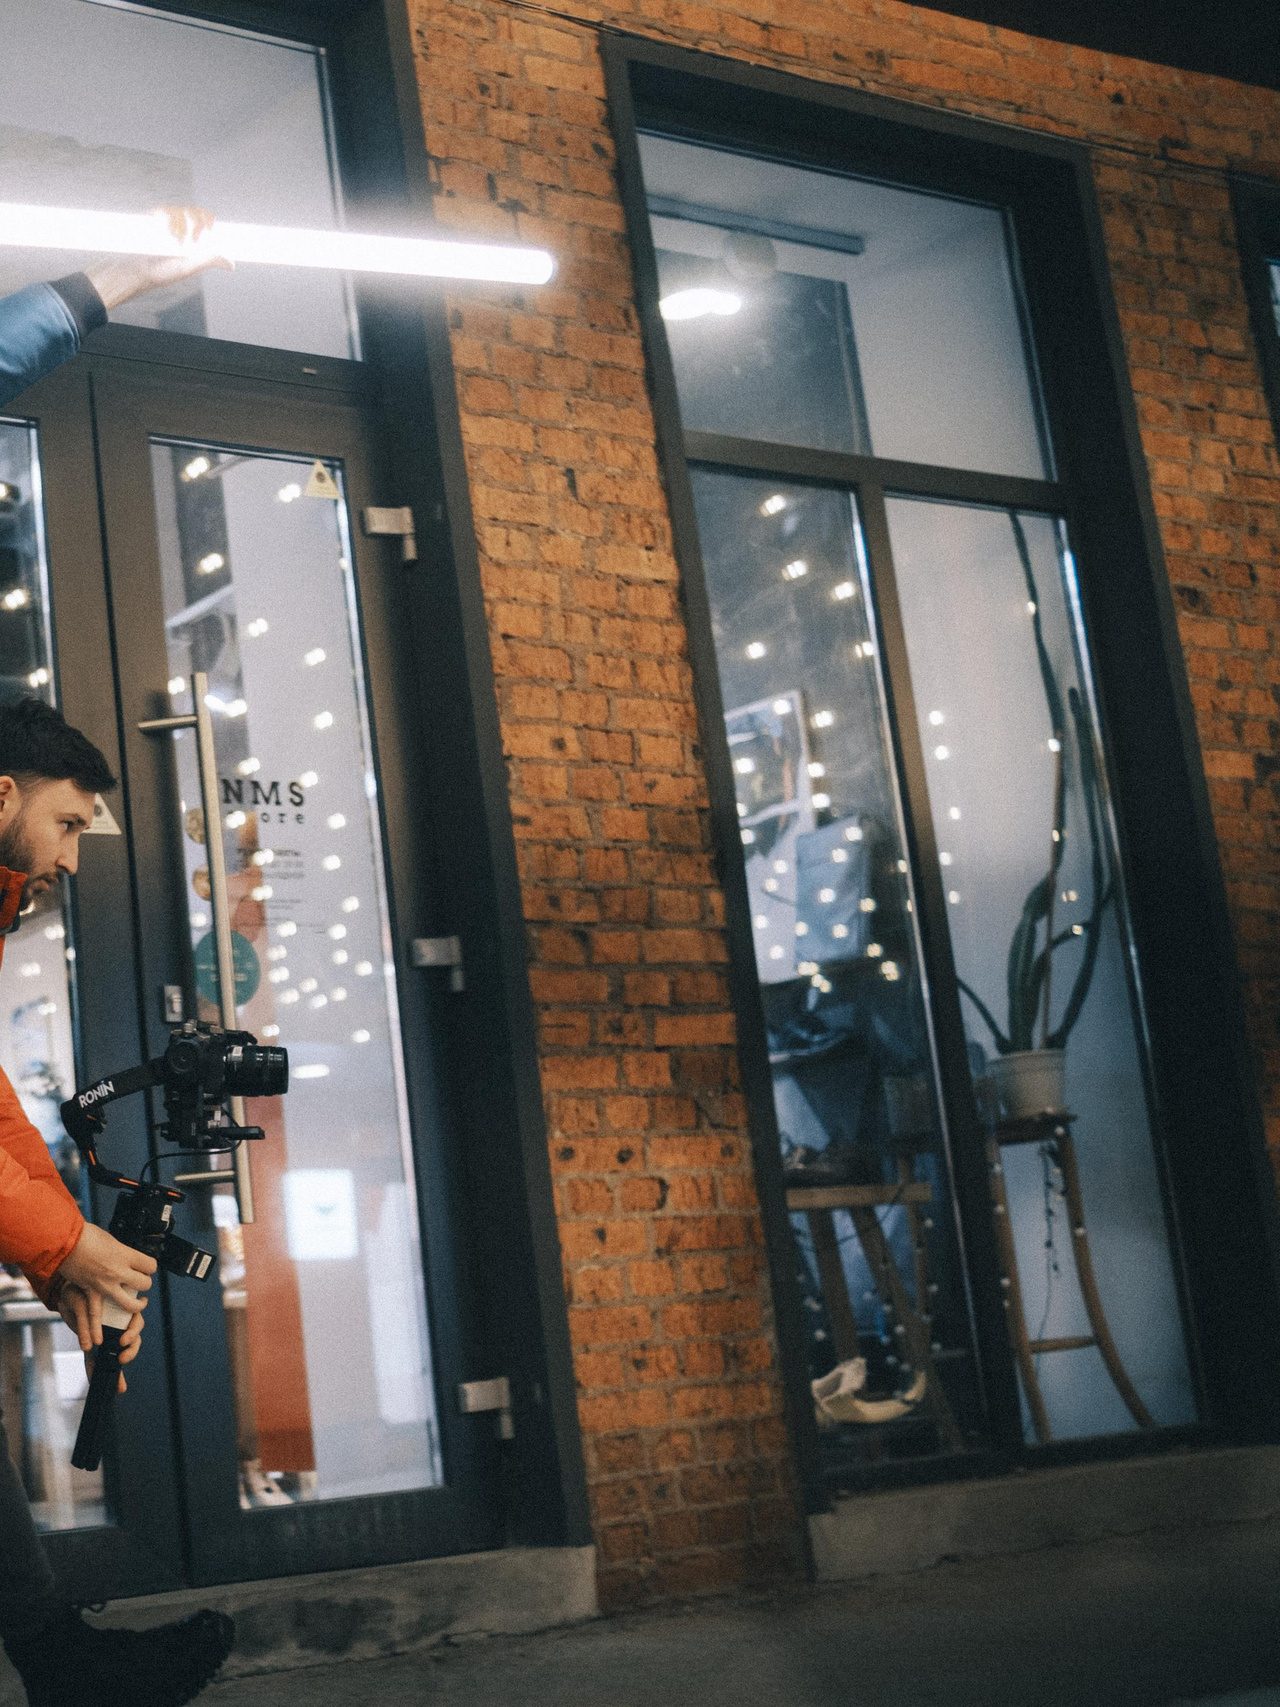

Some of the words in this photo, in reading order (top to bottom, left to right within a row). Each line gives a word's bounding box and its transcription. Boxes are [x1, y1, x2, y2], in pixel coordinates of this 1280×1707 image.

[221, 779, 304, 807] NMS
[228, 811, 305, 824] ore
[78, 1080, 115, 1108] RONIN
